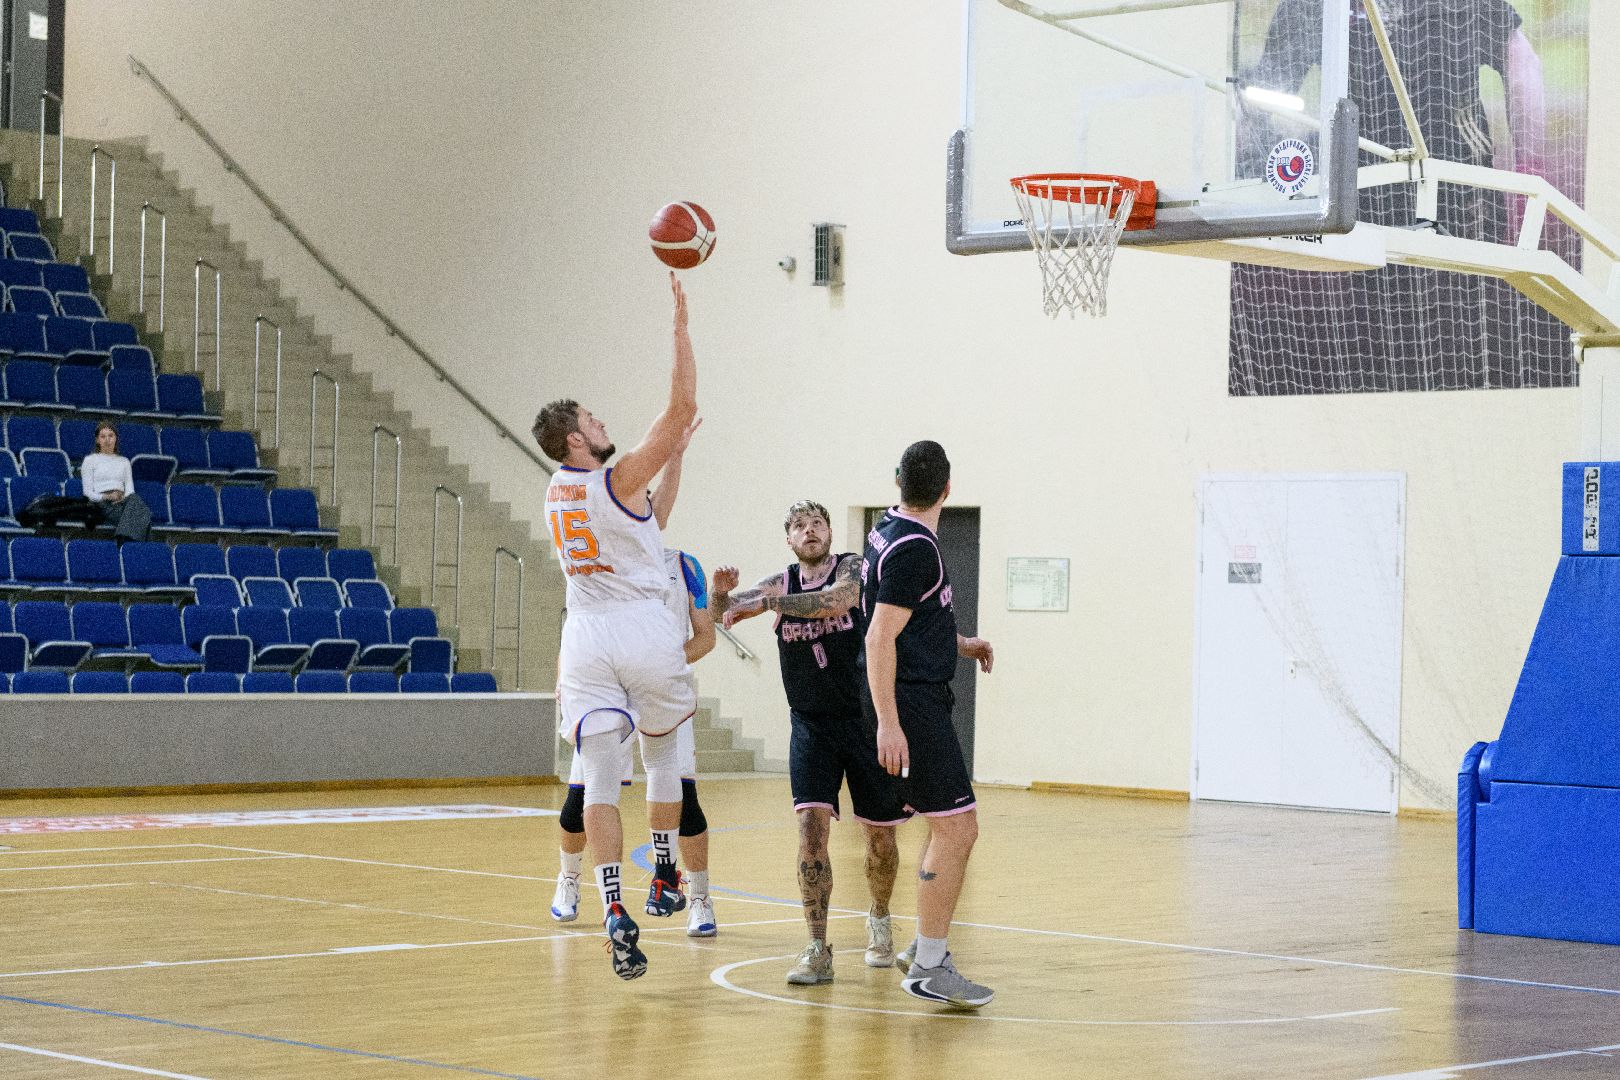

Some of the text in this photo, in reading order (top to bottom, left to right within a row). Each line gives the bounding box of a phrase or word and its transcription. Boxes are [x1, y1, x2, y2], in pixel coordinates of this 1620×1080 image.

[549, 508, 600, 560] 15
[811, 641, 828, 669] 0
[652, 832, 671, 865] ELITE
[602, 865, 621, 905] ELITE
